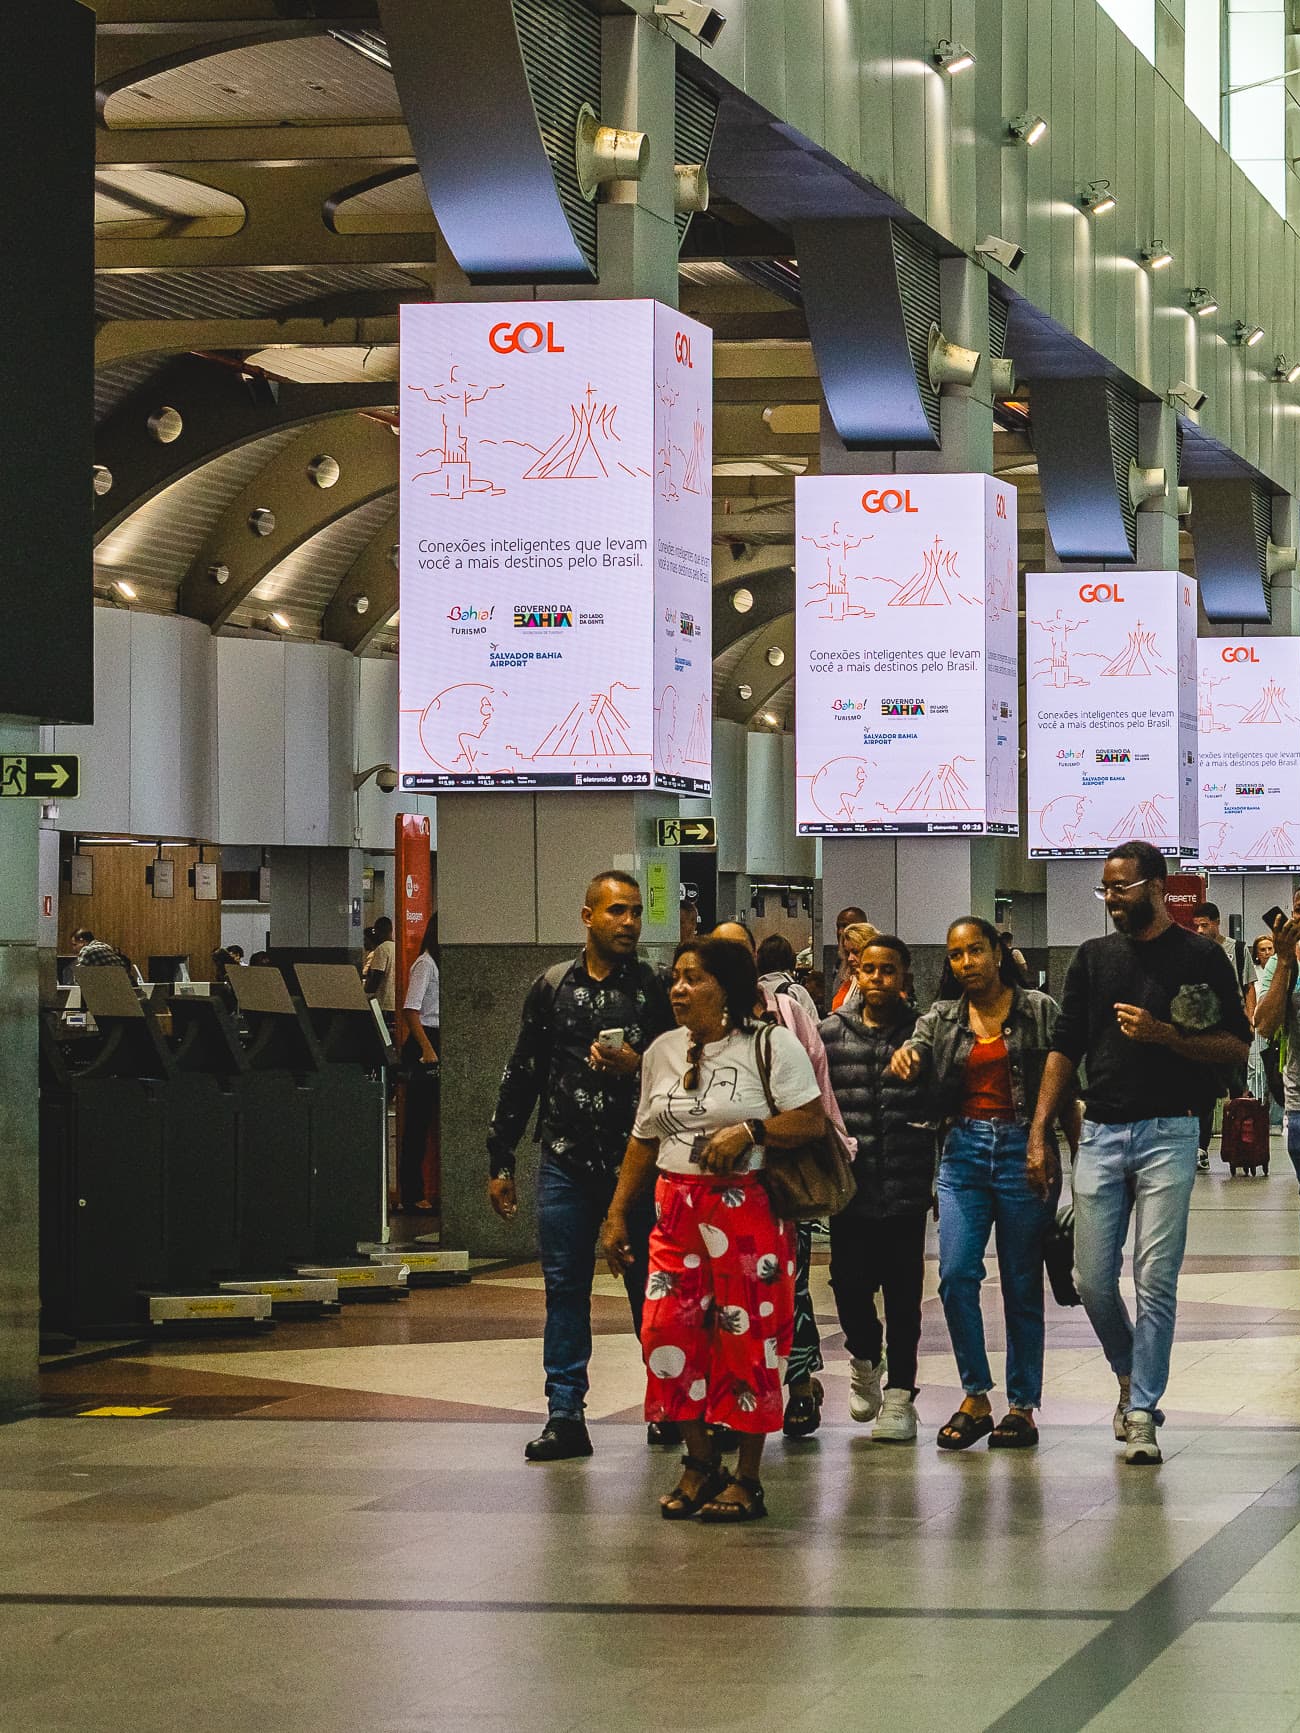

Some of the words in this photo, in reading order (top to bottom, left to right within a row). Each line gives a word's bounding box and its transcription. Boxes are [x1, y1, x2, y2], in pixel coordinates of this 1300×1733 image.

[489, 321, 565, 354] GOL
[675, 331, 693, 369] GOL
[862, 490, 919, 513] GOL
[418, 539, 486, 553] Conexões
[490, 538, 571, 555] inteligentes
[575, 539, 602, 553] que
[606, 537, 648, 550] levam
[418, 555, 450, 569] você
[455, 559, 463, 569] a
[468, 557, 500, 569] mais
[504, 555, 564, 568] destinos
[568, 554, 598, 571] pelo
[602, 553, 643, 568] Brasil.
[1079, 584, 1125, 603] GOL
[450, 627, 487, 635] TURISMO
[810, 650, 861, 660] Conexões
[864, 650, 924, 662] inteligentes
[927, 651, 947, 660] que
[950, 649, 981, 659] levam
[1222, 647, 1260, 663] GOL
[810, 662, 834, 672] você
[838, 664, 843, 672] a
[847, 663, 870, 672] mais
[874, 661, 918, 672] destinos
[921, 661, 944, 673] pelo
[948, 661, 978, 671] Brasil.
[1080, 710, 1128, 720] inteligentes
[1131, 711, 1147, 719] que
[1149, 709, 1175, 718] levam
[1067, 721, 1087, 729] mais
[1089, 720, 1125, 729] destinos
[1127, 720, 1144, 730] pelo
[621, 774, 648, 783] 09:26
